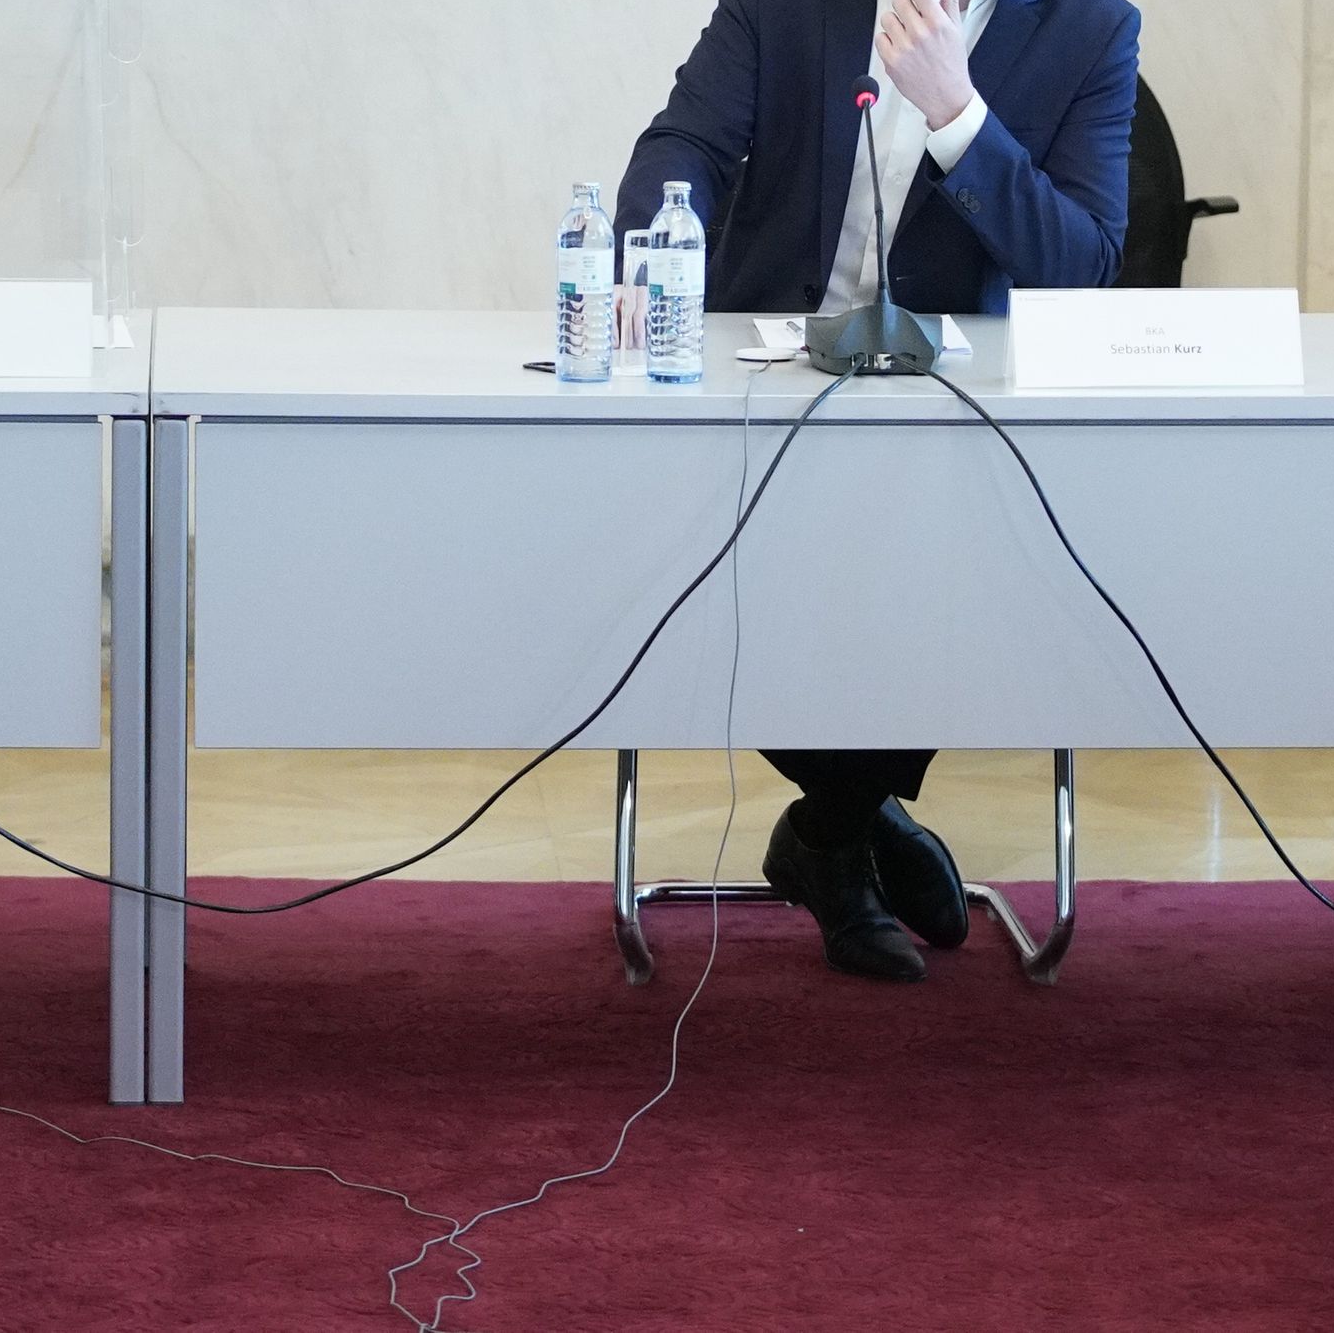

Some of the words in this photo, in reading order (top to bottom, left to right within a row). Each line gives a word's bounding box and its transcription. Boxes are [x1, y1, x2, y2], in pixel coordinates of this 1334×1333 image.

[1145, 327, 1165, 336] BKA
[1110, 344, 1171, 354] Sebastian
[1174, 344, 1203, 354] Kurz
